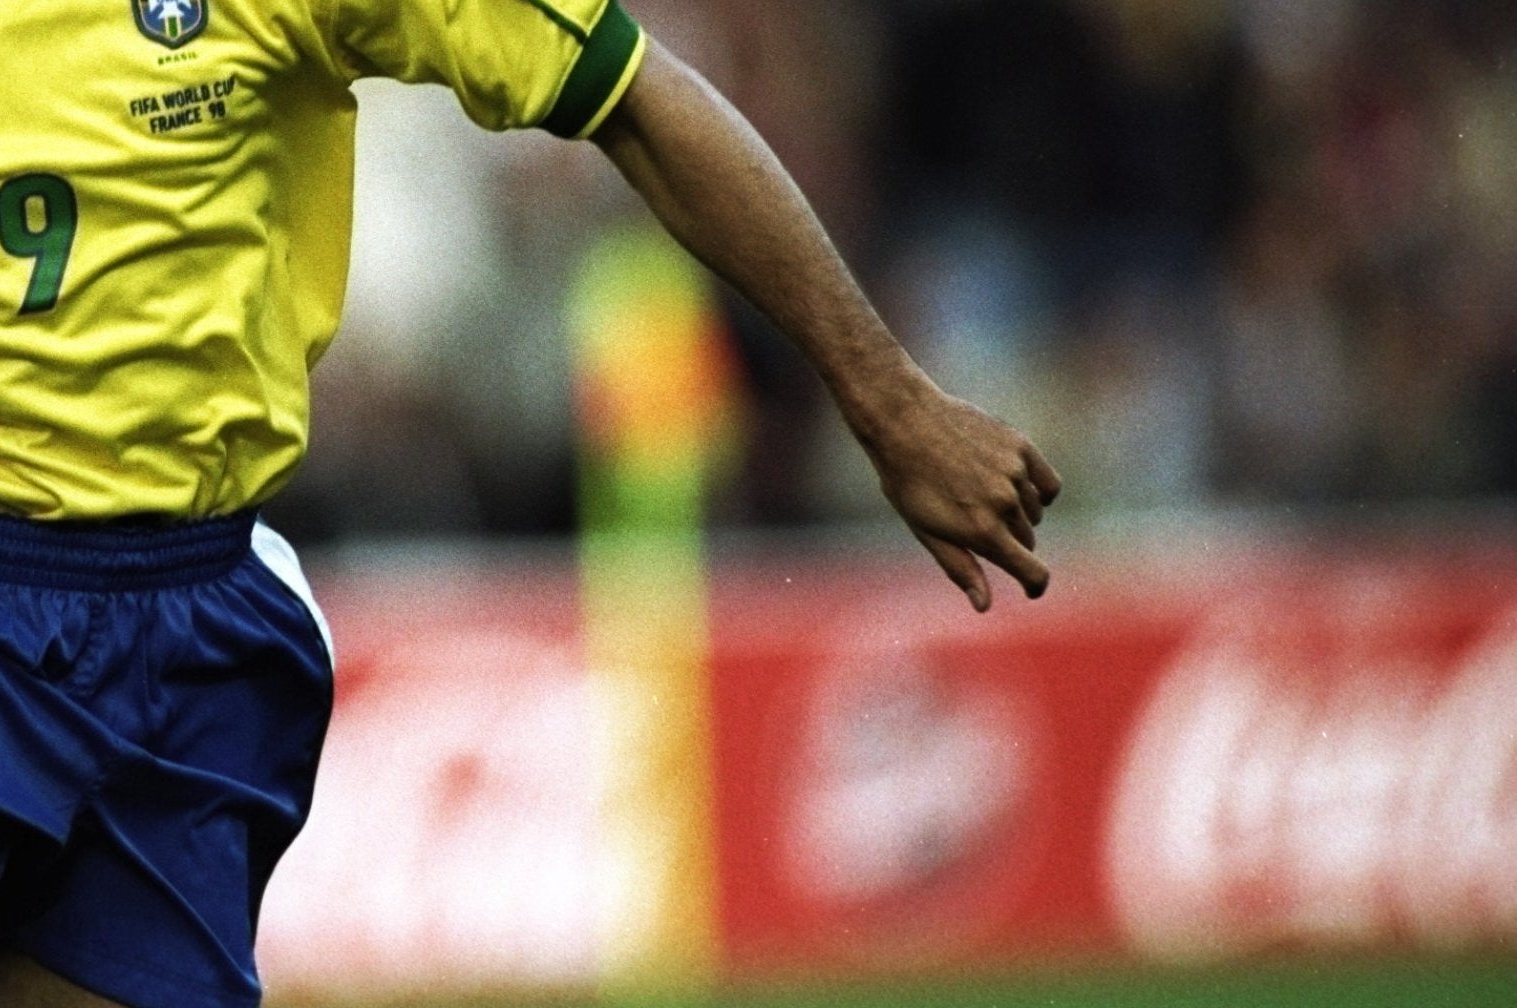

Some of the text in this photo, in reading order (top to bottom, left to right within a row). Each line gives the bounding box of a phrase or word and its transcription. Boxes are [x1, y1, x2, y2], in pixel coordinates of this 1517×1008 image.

[158, 52, 197, 65] BRASIL
[130, 97, 160, 117] FIFA
[162, 84, 210, 109] WORLD
[149, 100, 226, 133] FRANCE 98
